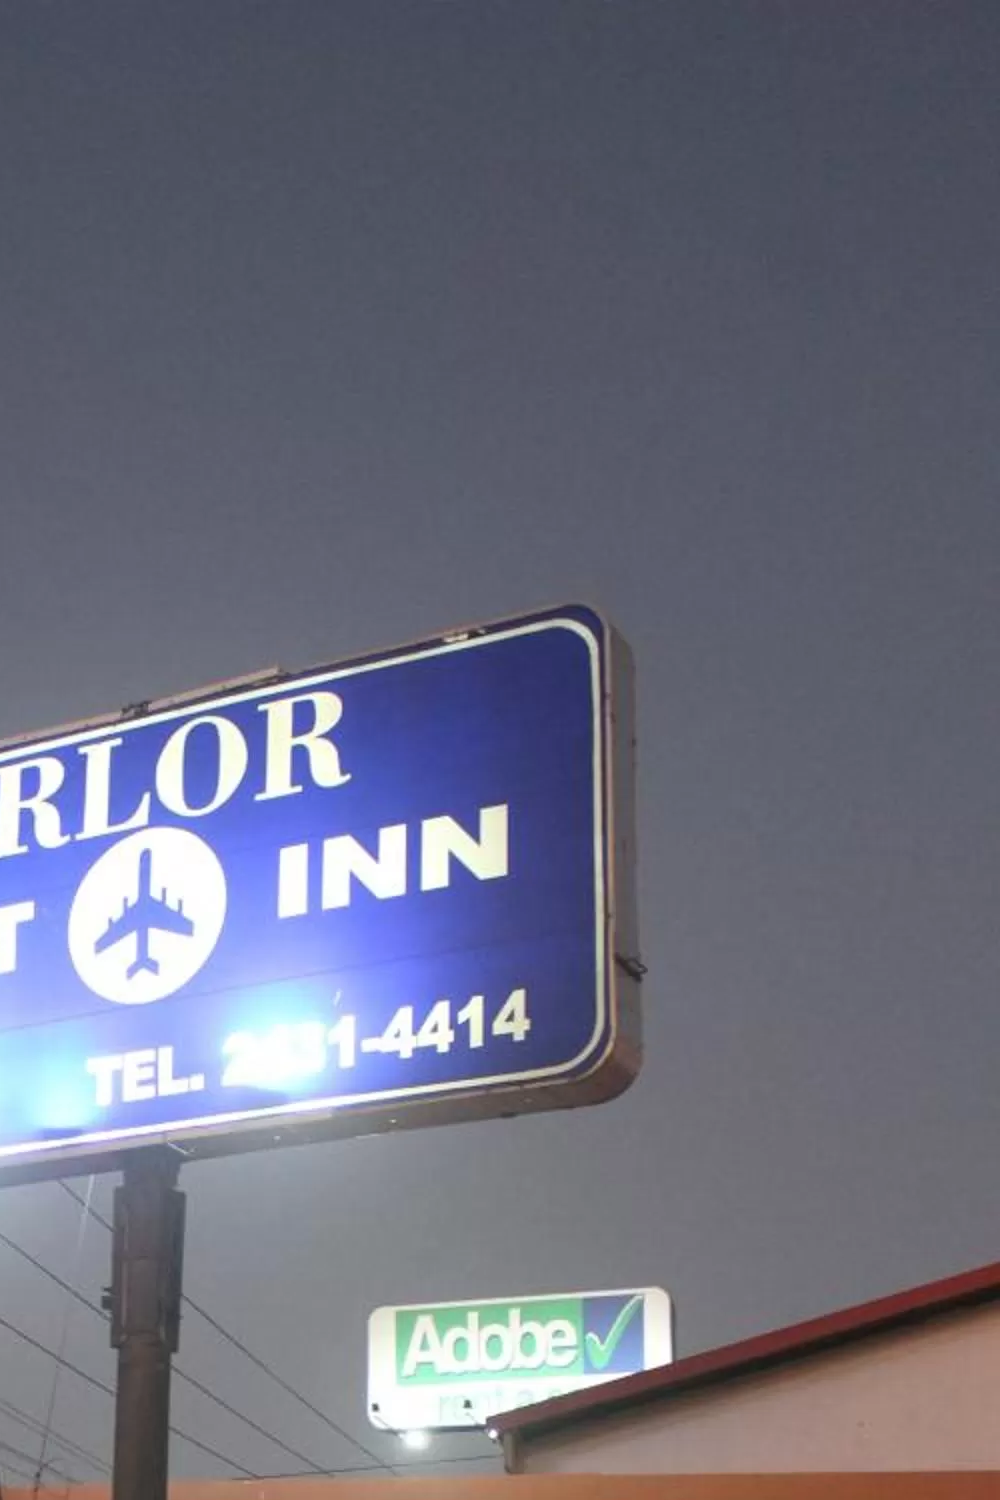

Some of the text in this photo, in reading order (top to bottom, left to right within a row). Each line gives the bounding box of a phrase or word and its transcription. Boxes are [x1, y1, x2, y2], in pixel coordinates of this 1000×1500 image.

[277, 804, 509, 920] INN
[85, 988, 531, 1107] TEL. 21-4414
[401, 1308, 579, 1377] Adobe
